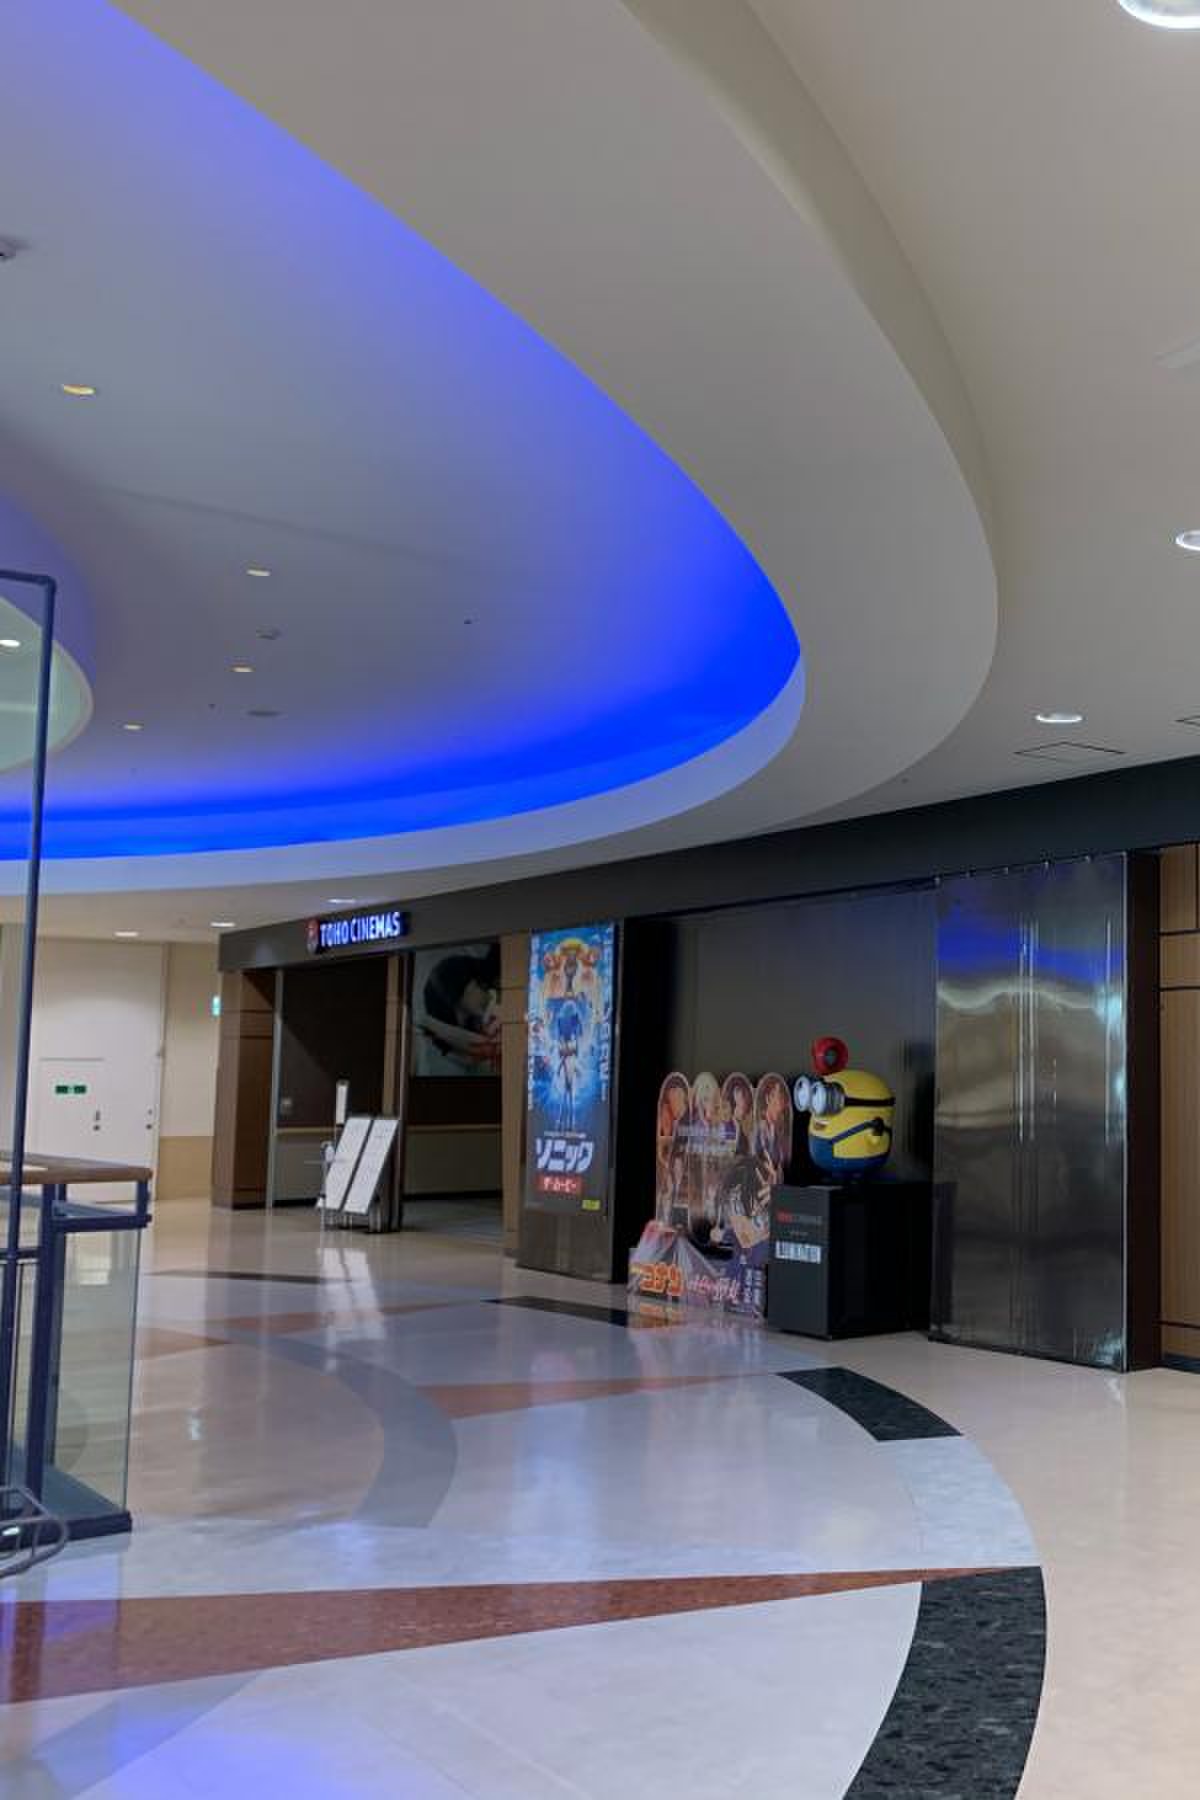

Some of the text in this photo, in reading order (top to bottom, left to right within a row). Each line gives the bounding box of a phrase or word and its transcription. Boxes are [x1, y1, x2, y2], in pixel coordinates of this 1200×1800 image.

[320, 911, 400, 947] TOHO CINEMAS
[536, 1138, 594, 1173] ソニック
